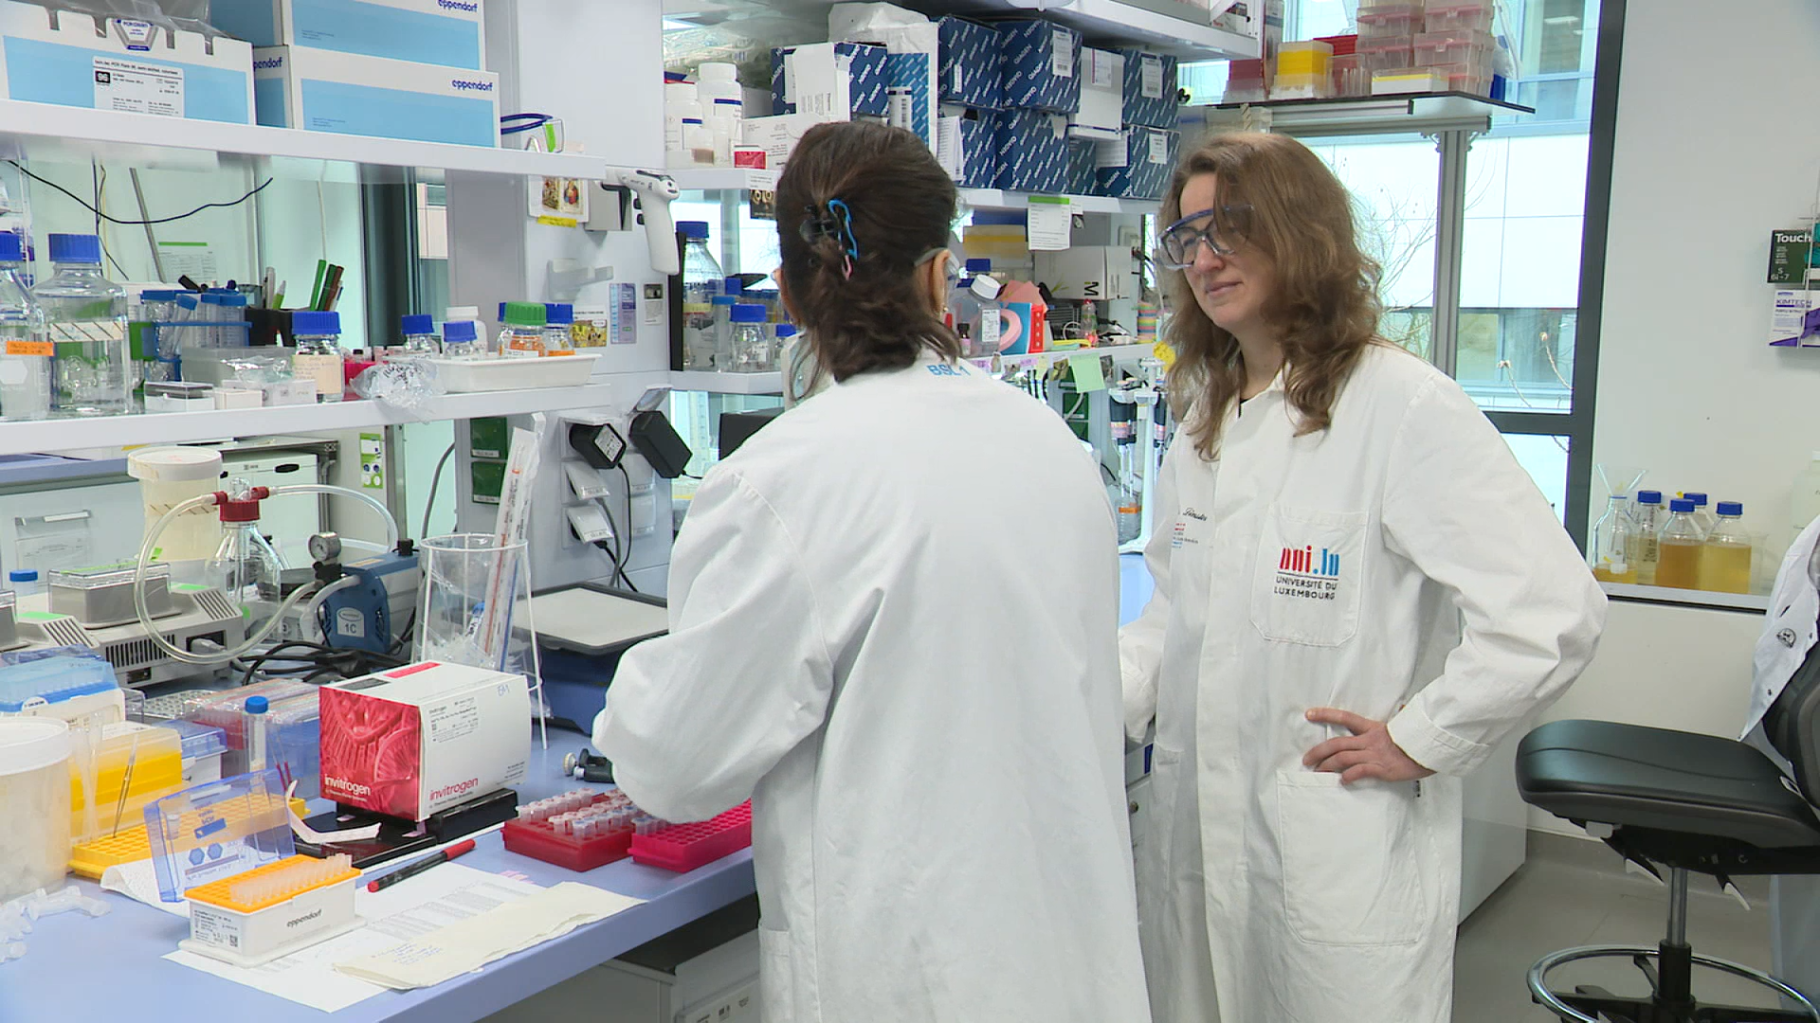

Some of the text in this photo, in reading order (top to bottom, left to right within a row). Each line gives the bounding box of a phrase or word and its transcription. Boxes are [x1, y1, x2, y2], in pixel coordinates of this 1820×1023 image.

[437, 0, 478, 12] eppendorf
[253, 57, 283, 72] pendorf
[451, 78, 493, 91] eppendorf
[1276, 576, 1337, 590] UNIVERSITÉ DU
[1274, 586, 1335, 600] LUXEMBOURG
[345, 623, 357, 634] 1C
[324, 773, 372, 796] invitrogen
[429, 777, 479, 802] invitrogen
[286, 908, 323, 929] eppendorf
